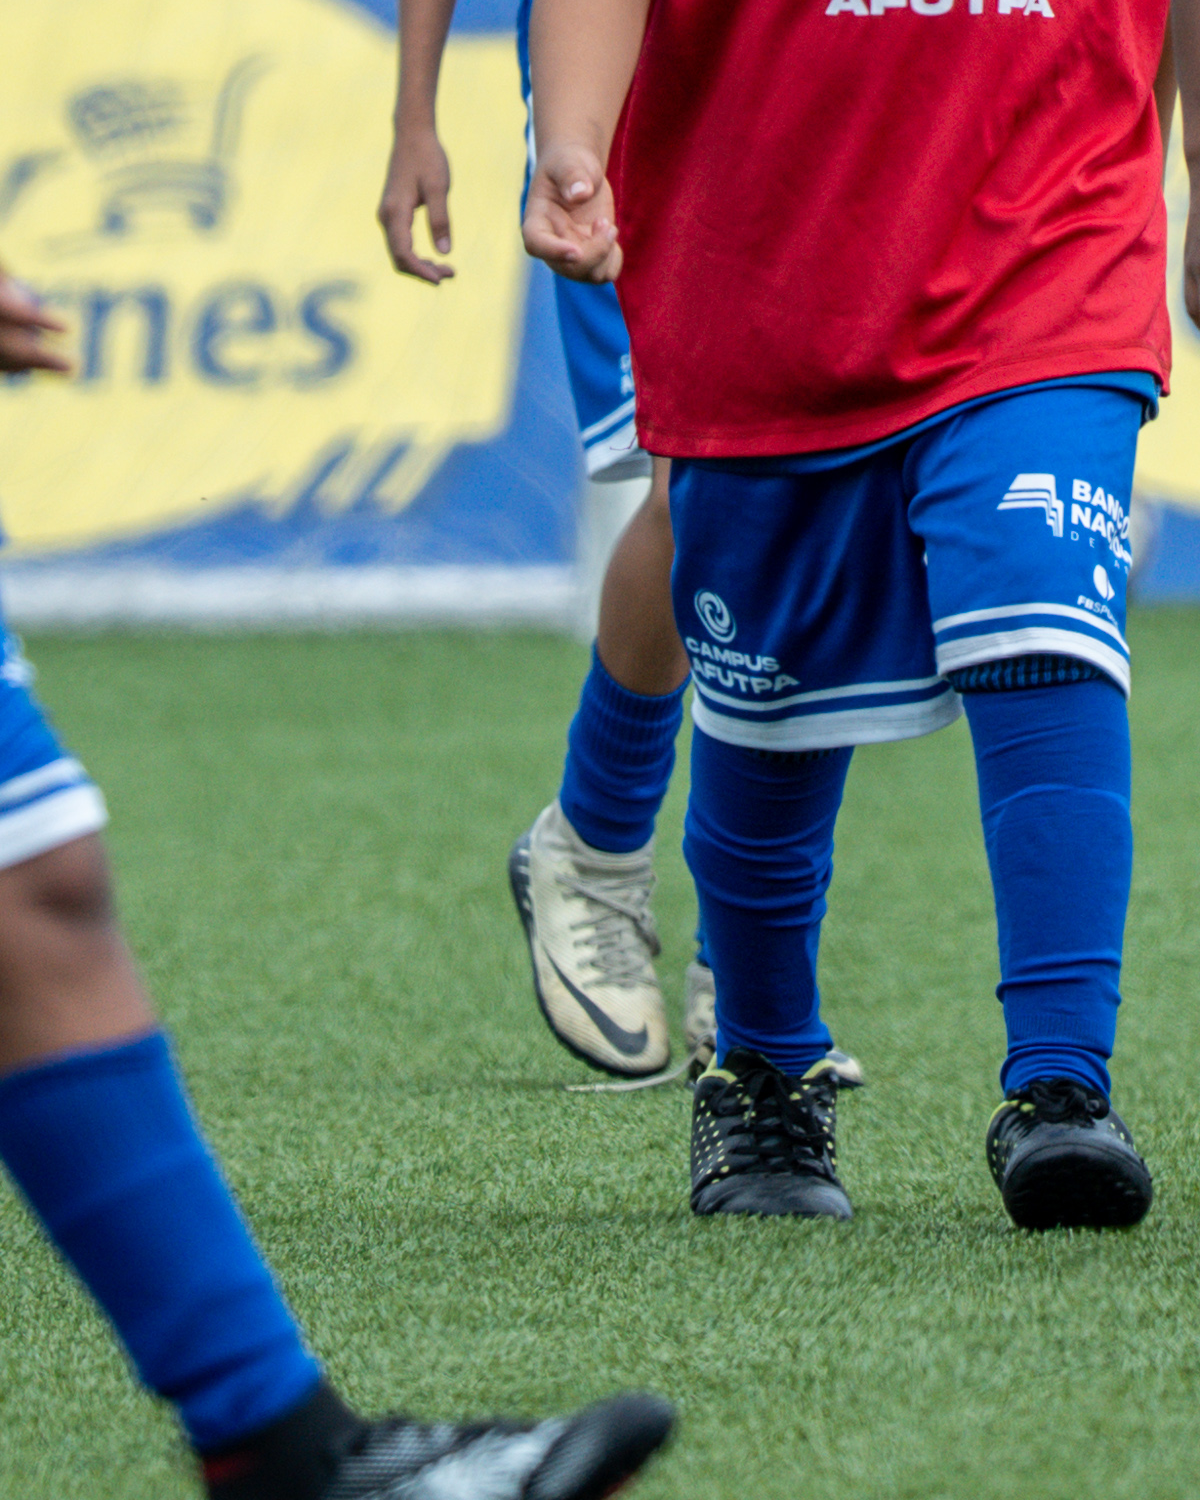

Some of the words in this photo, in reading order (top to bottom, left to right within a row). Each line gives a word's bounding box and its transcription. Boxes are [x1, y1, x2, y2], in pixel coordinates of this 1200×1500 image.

[1072, 481, 1130, 540] BANCO
[685, 636, 780, 672] CAMPUS
[692, 656, 800, 694] AFUTPA
